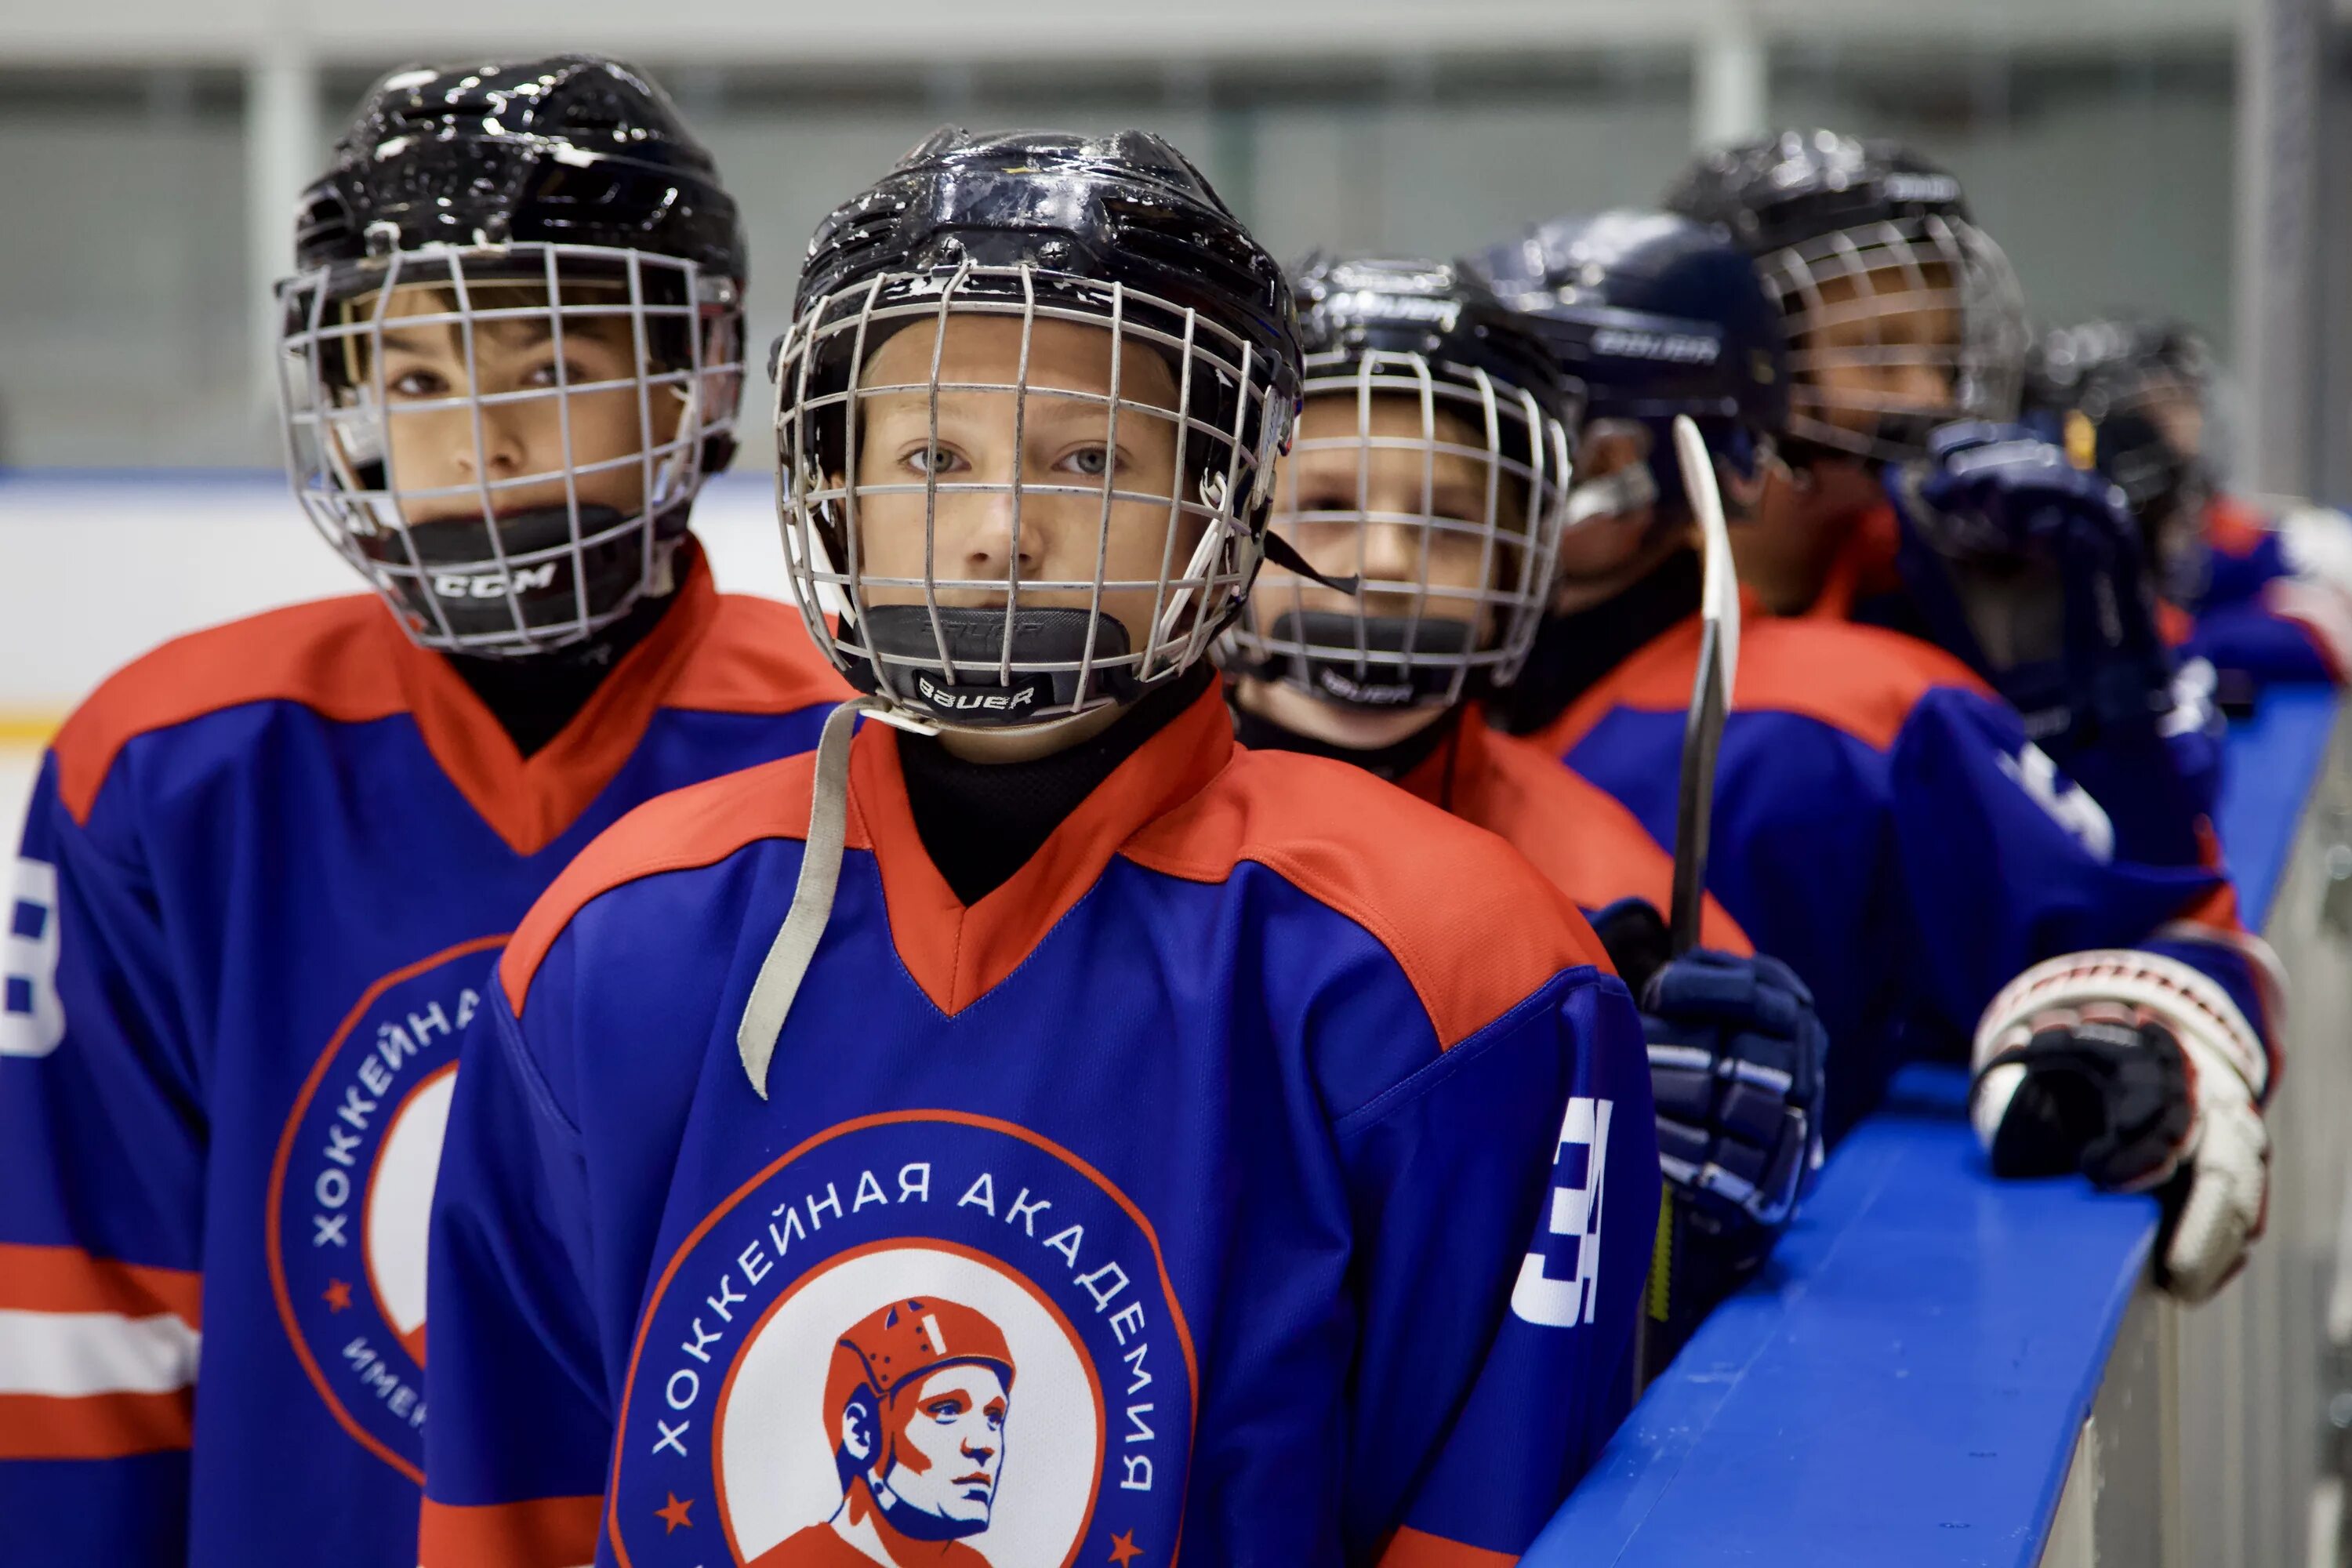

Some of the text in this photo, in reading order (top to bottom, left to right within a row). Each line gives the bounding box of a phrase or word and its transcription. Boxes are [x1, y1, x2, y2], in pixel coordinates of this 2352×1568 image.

[1327, 291, 1462, 324] UER
[435, 561, 557, 598] CCM
[919, 677, 1035, 710] BAUER
[652, 1163, 1155, 1491] ХОККЕЙНАЯ АКАДЕМИЯ
